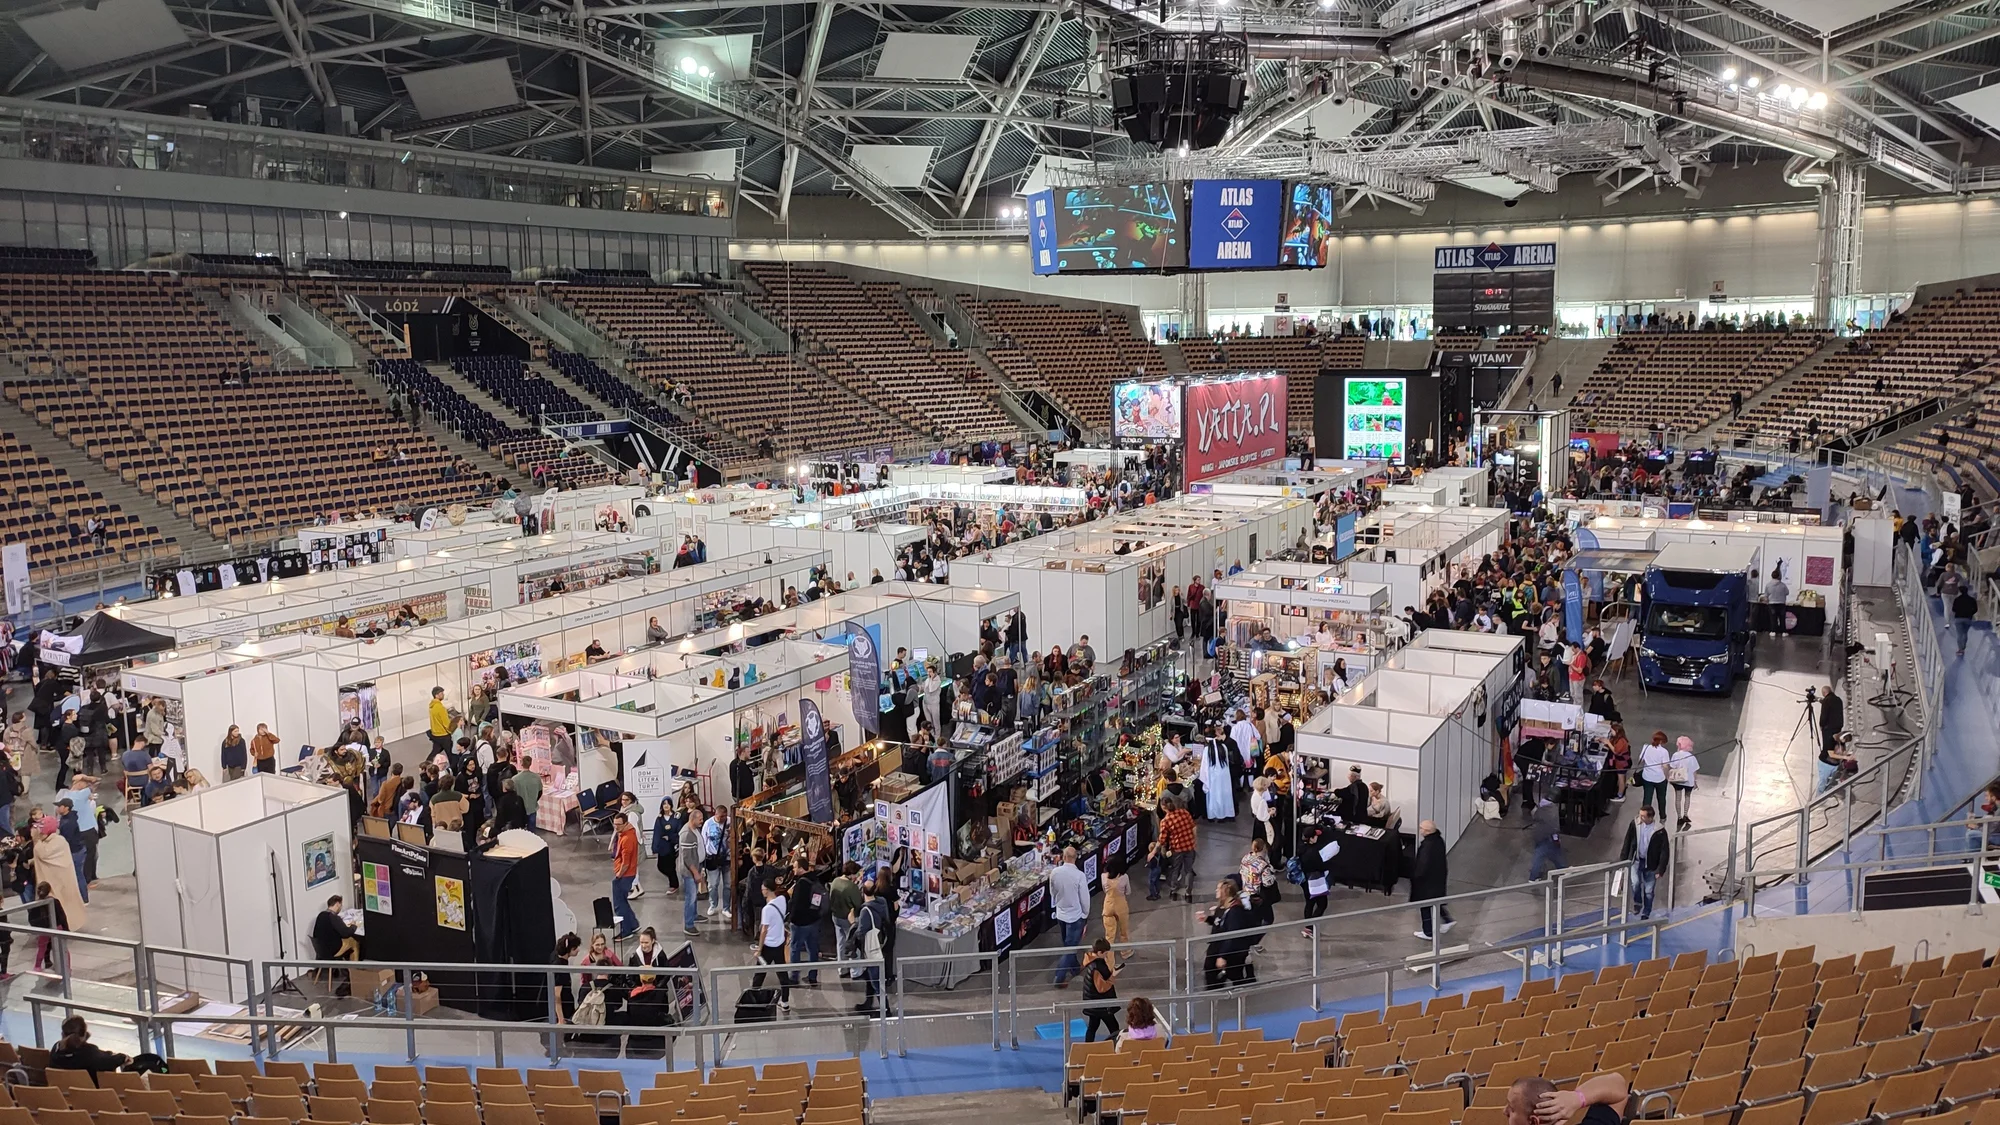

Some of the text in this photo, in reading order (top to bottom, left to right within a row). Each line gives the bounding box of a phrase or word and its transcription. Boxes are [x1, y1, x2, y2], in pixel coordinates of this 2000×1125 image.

[1220, 187, 1253, 206] ATLAS
[1227, 219, 1243, 228] ATLAS
[1217, 241, 1252, 260] ARENA
[1437, 245, 1553, 267] ATLAS ARENA
[1484, 252, 1501, 261] ATLAS
[385, 298, 420, 312] ŁÓDŹ
[1469, 353, 1513, 363] WITAMY
[1197, 392, 1279, 453] YATTA.PL
[567, 426, 582, 437] ATLAS
[675, 715, 685, 724] Dom
[684, 709, 703, 722] Literatury
